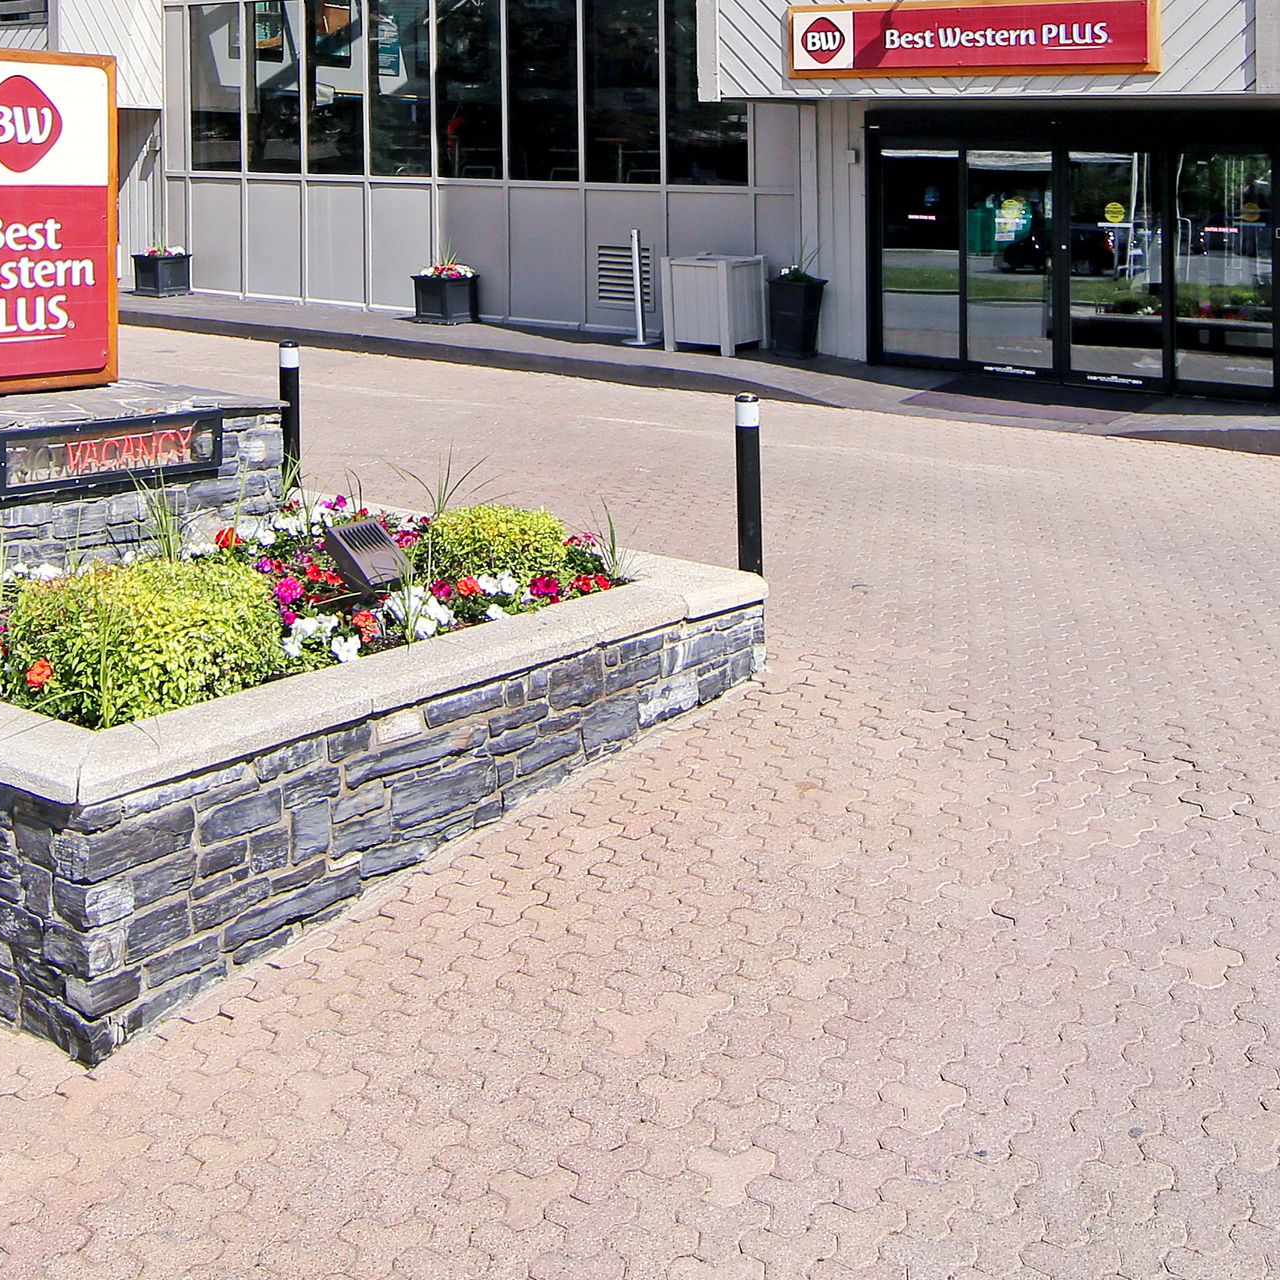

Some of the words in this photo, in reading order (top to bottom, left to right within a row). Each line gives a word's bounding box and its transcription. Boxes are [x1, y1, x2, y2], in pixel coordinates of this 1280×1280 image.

[806, 30, 841, 51] BW
[885, 29, 935, 49] Best
[938, 26, 1036, 48] Western
[65, 428, 193, 470] VACANCY
